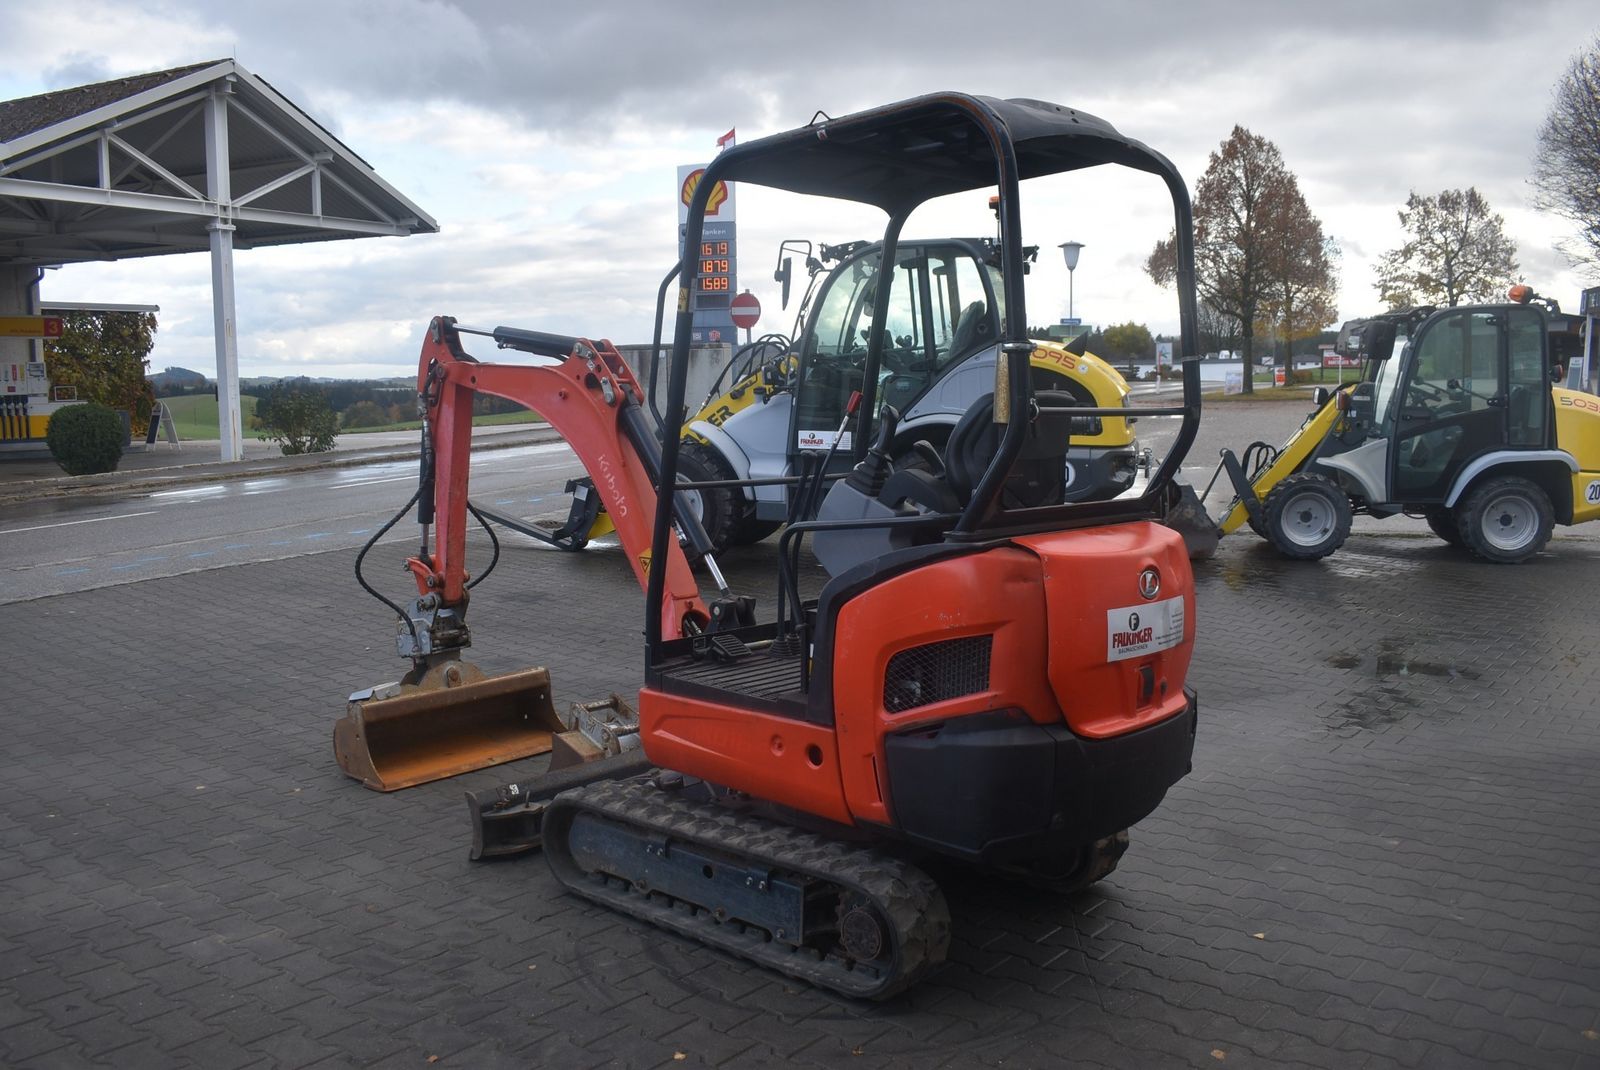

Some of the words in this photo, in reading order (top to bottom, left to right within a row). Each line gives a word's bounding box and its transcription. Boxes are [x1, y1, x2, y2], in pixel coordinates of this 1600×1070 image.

[49, 321, 58, 334] 3
[1560, 396, 1600, 414] 503
[598, 454, 627, 517] Kubota
[1588, 484, 1600, 500] 20
[1112, 627, 1153, 649] FALKINGER
